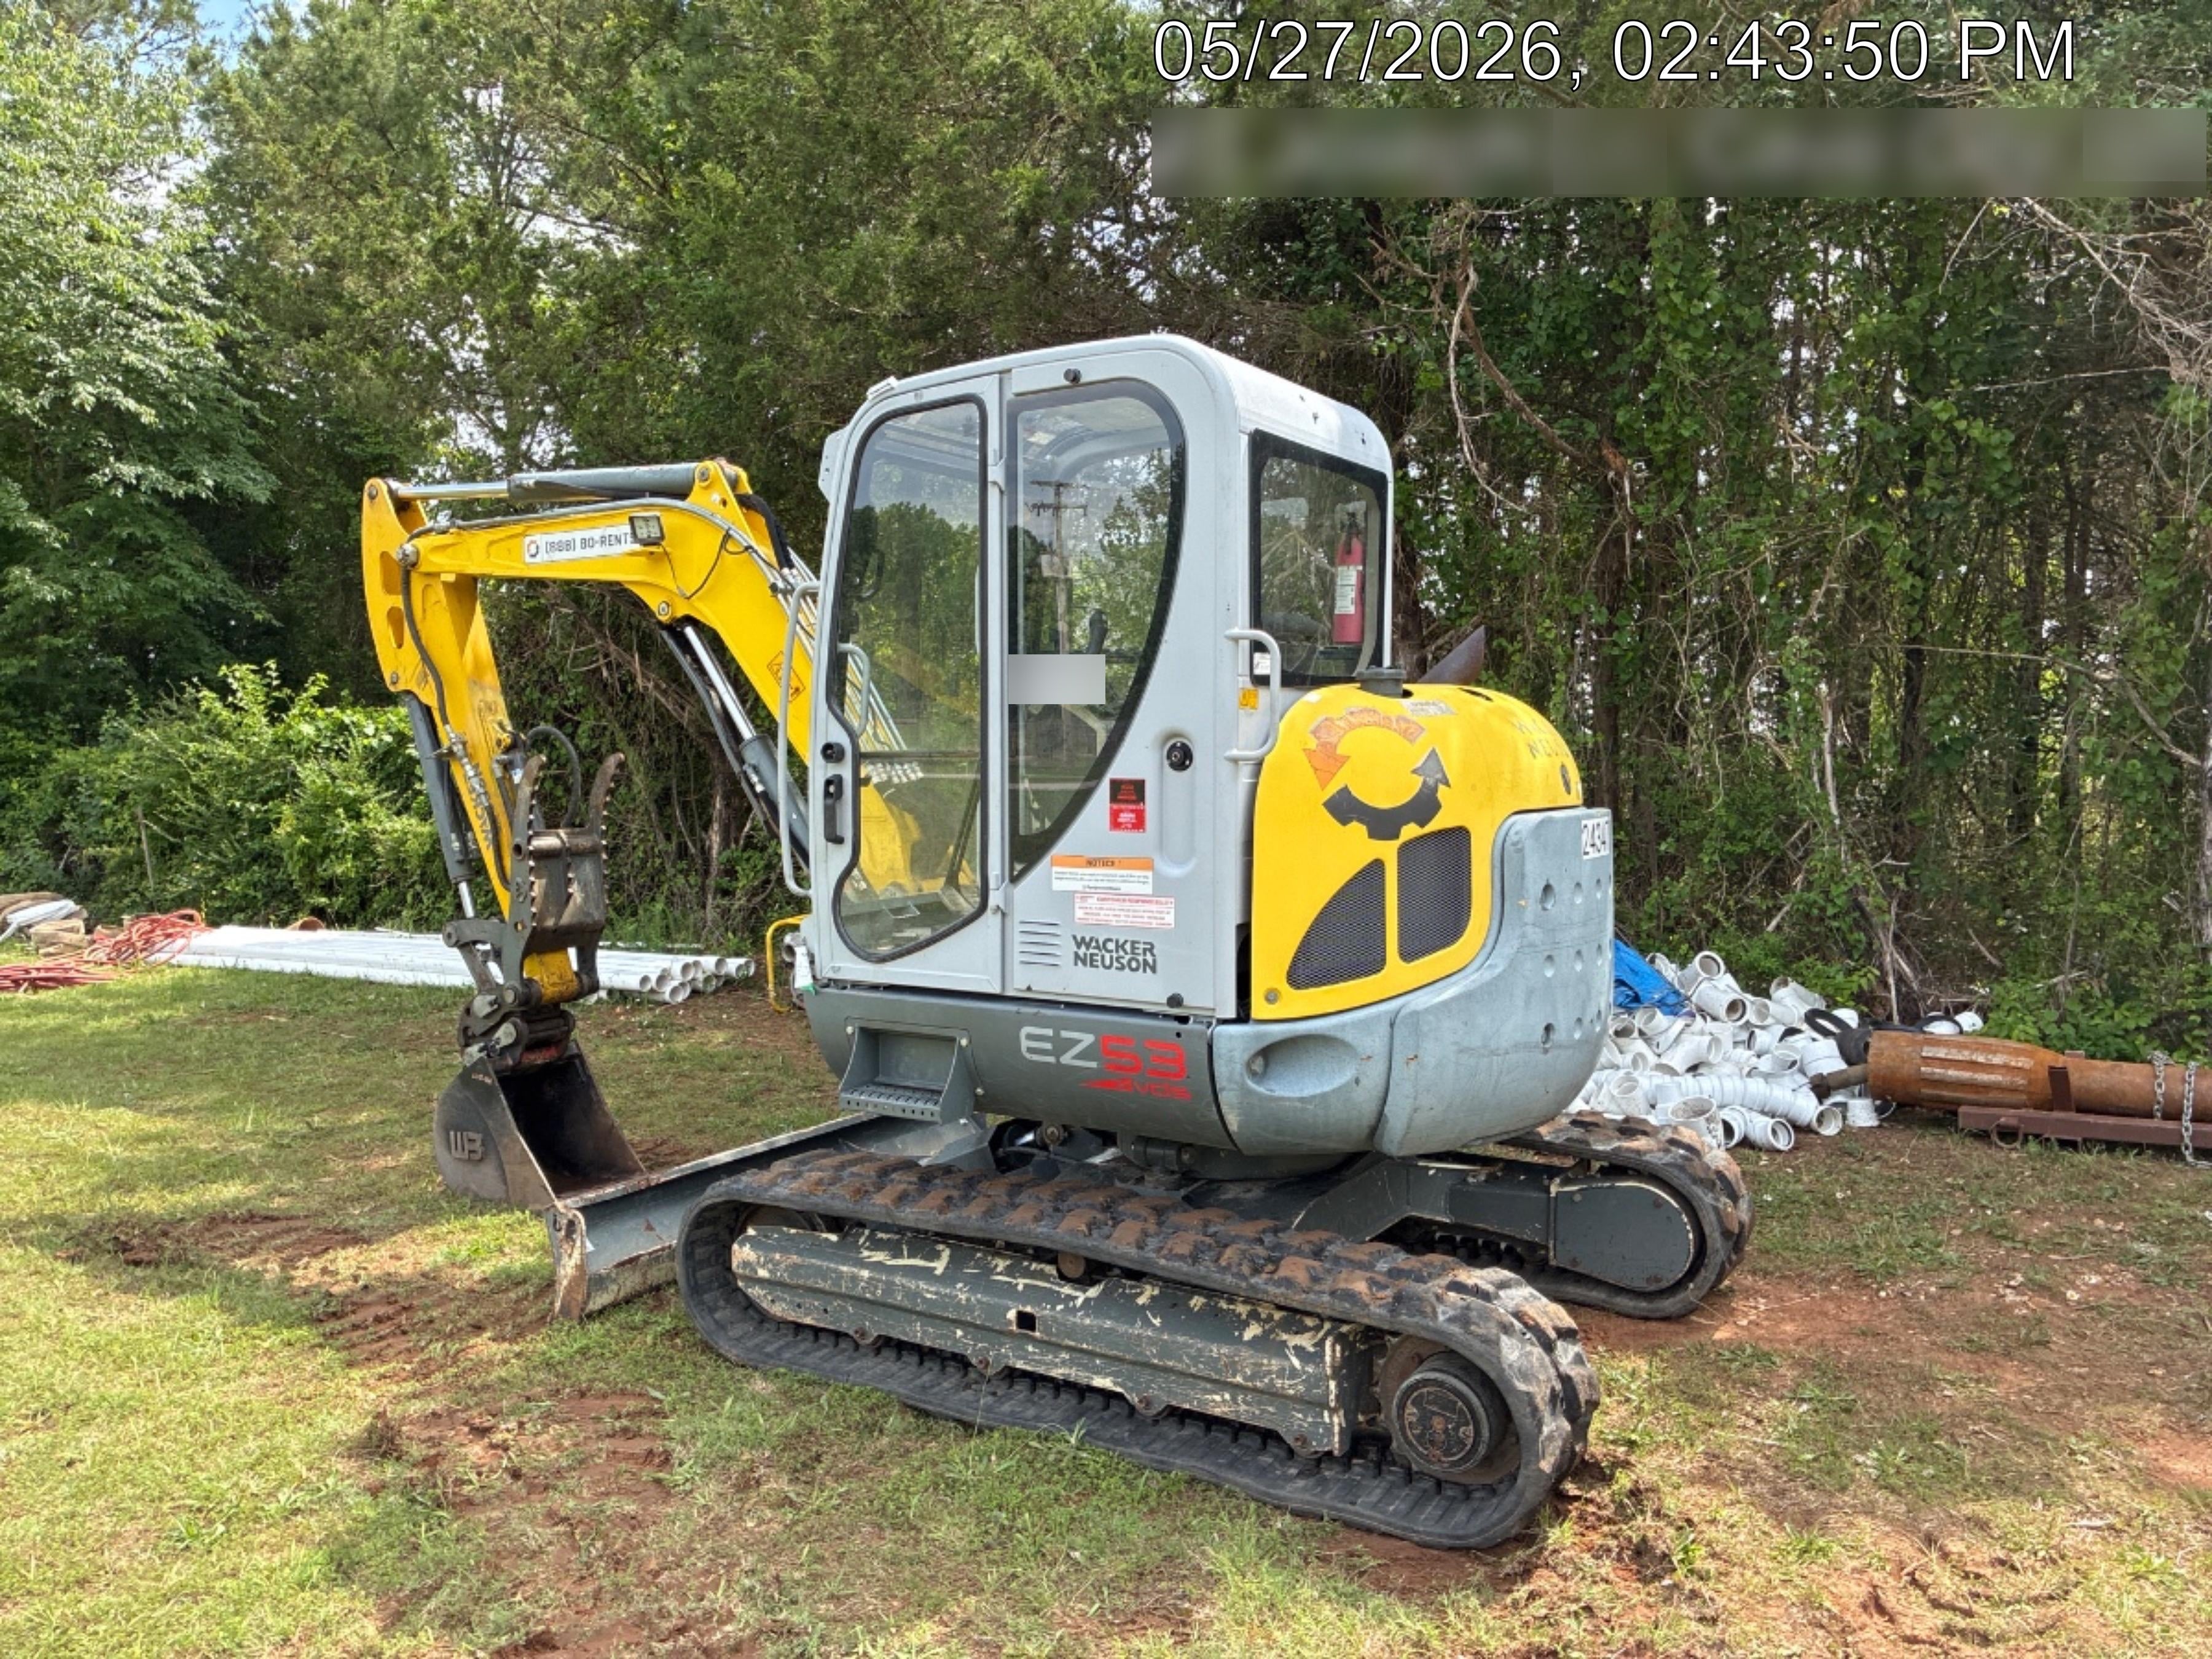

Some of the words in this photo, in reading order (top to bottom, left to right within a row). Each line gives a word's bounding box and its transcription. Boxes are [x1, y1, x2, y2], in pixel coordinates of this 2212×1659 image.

[1072, 934, 1156, 957] WACKER
[1073, 951, 1156, 974] NEUSON
[1019, 1026, 1188, 1081] EZ53
